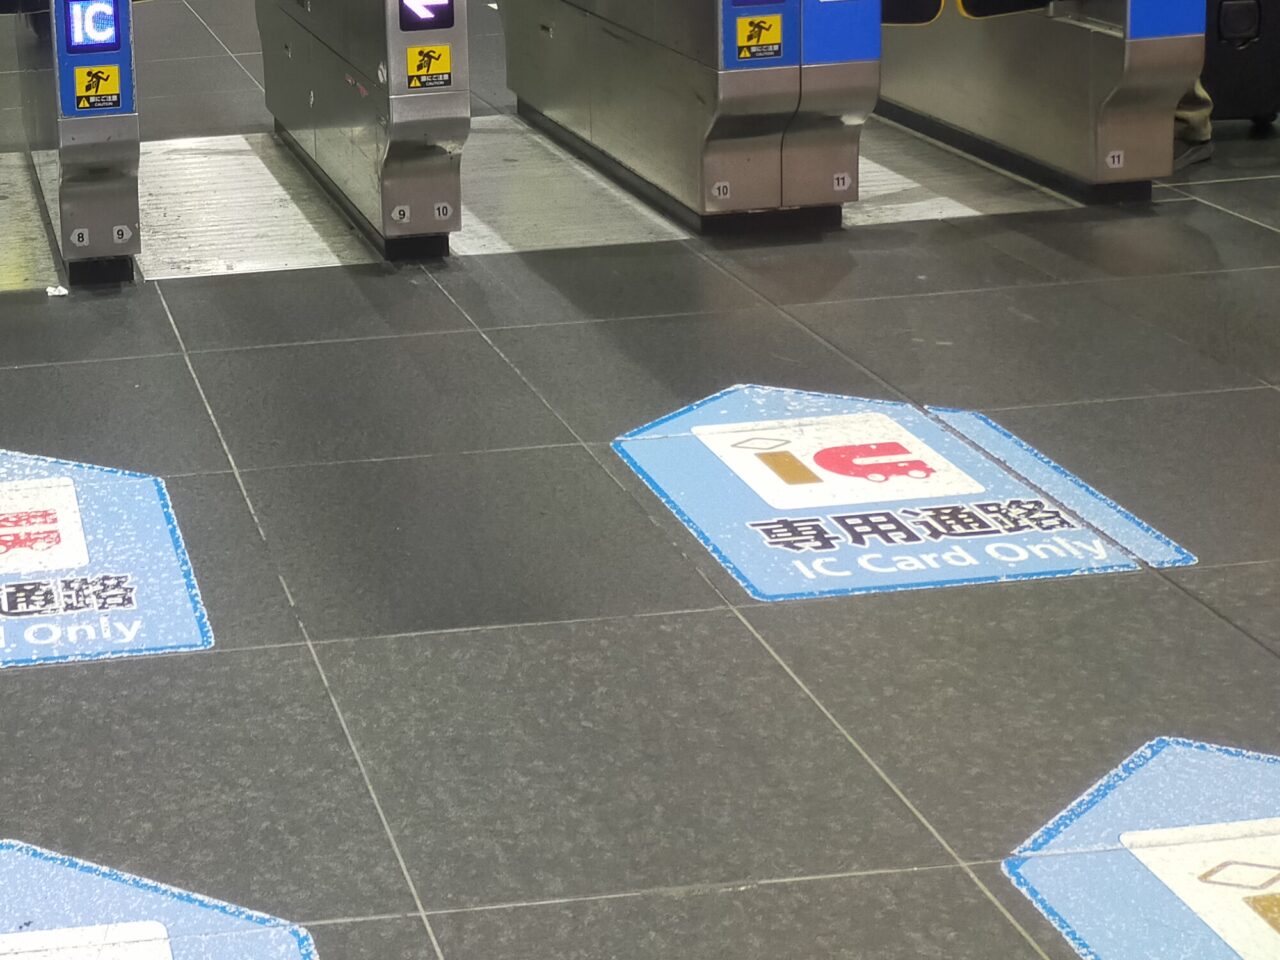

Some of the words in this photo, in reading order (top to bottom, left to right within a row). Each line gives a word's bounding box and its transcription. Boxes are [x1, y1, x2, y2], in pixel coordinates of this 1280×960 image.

[72, 2, 114, 43] IC
[1110, 154, 1121, 165] 11
[835, 176, 846, 187] 11
[716, 185, 728, 197] 10
[398, 209, 406, 220] 9
[436, 206, 448, 217] 10
[77, 232, 85, 243] 8
[116, 229, 124, 240] 9
[750, 499, 1080, 552] 専用通路
[792, 557, 852, 580] IC
[858, 545, 979, 574] Card
[985, 534, 1108, 563] Only
[23, 614, 141, 645] Only
